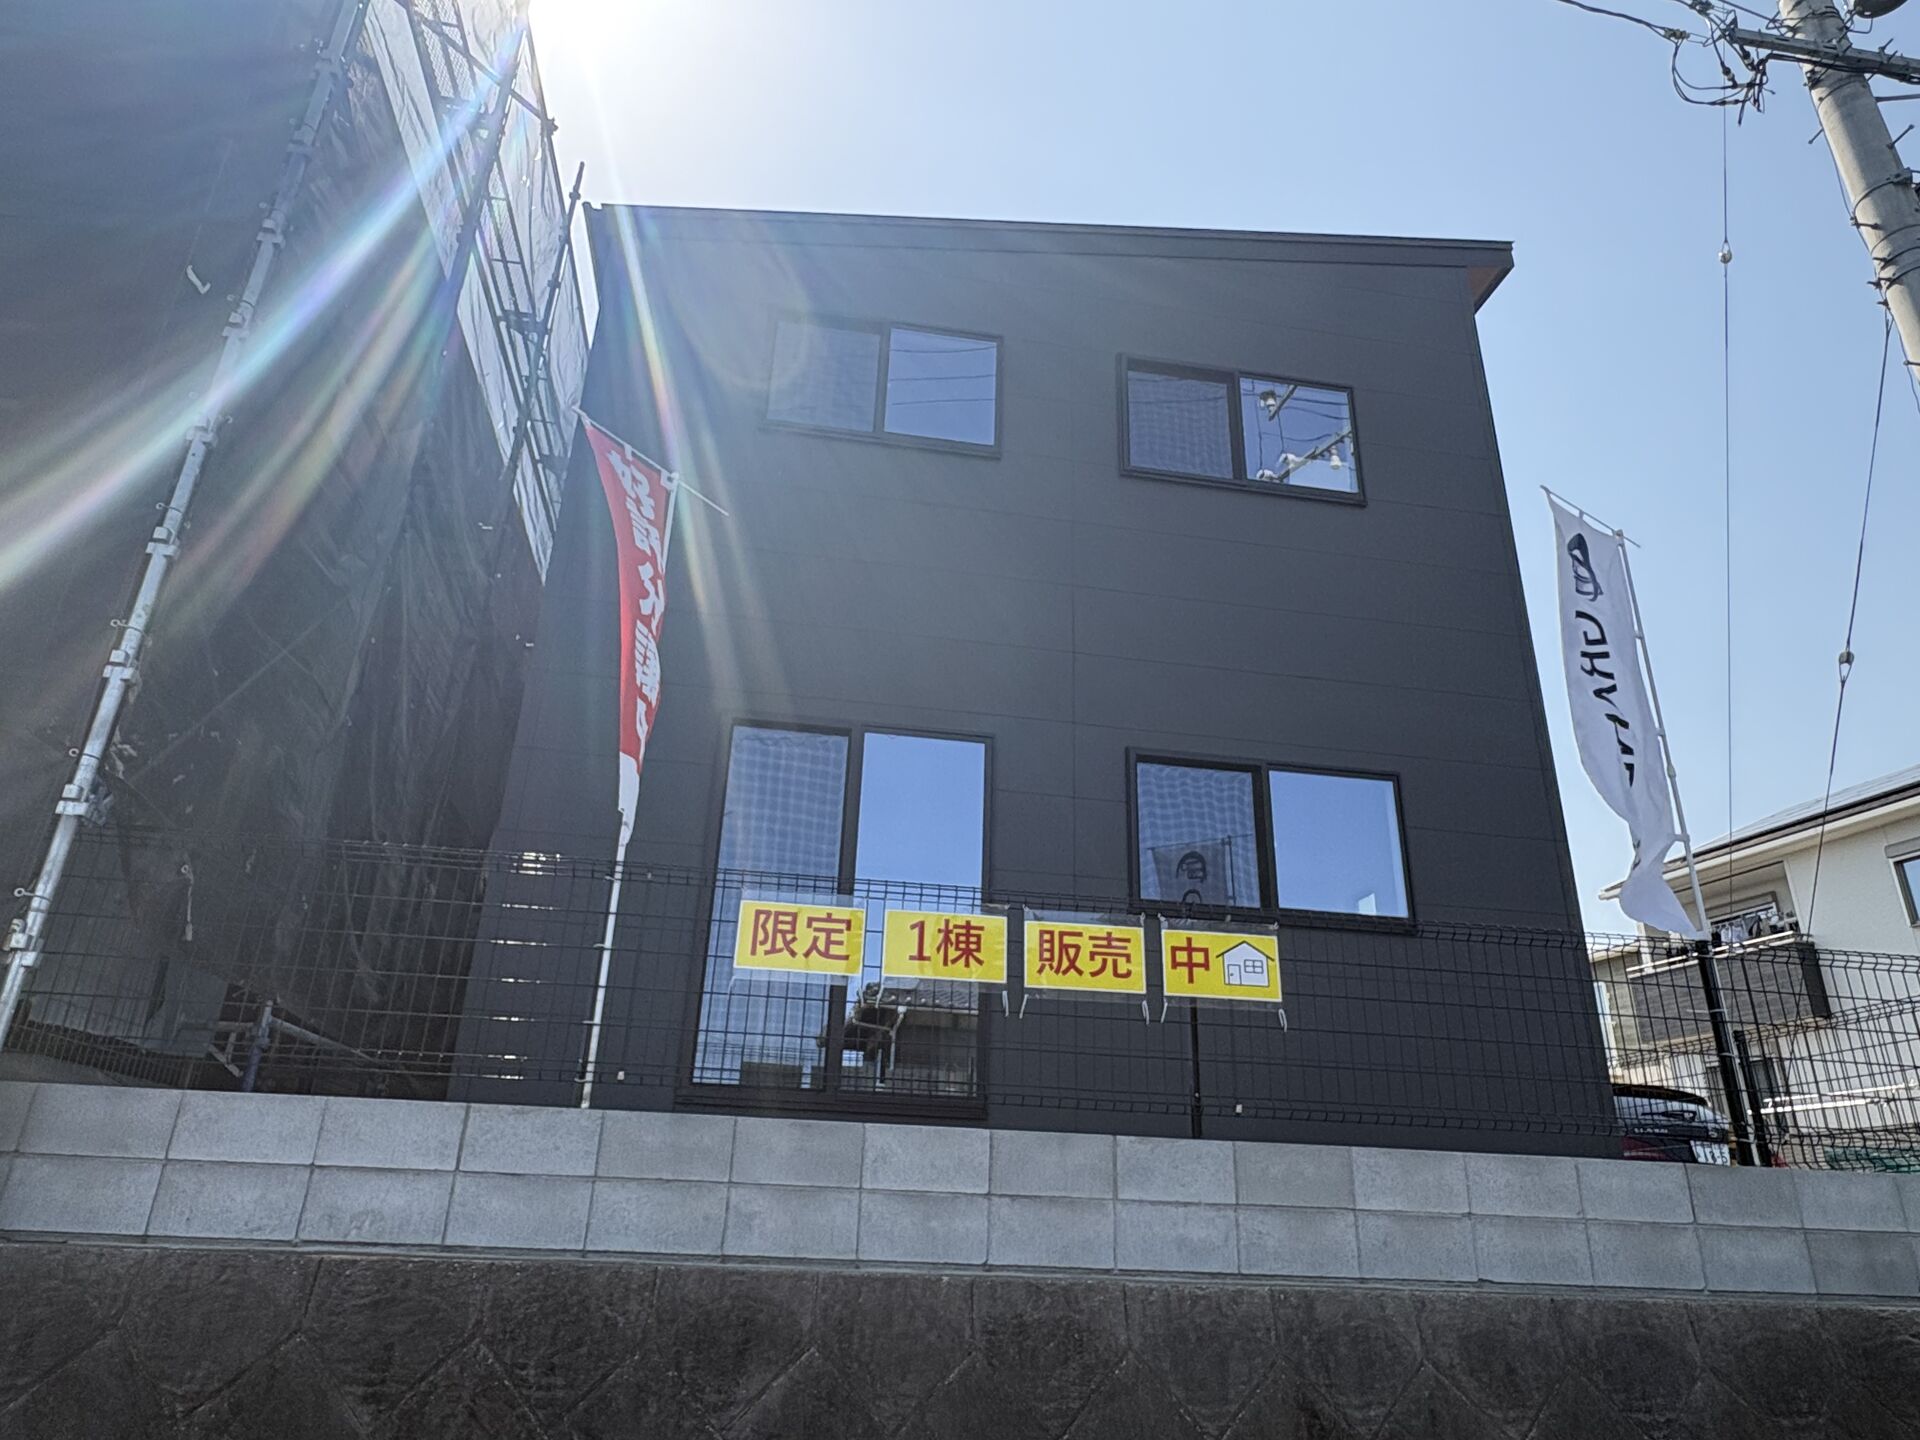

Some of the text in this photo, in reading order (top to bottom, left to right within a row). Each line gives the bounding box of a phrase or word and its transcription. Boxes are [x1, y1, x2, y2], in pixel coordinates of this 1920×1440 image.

[750, 909, 1210, 984] 限定 1棟 販売 中
